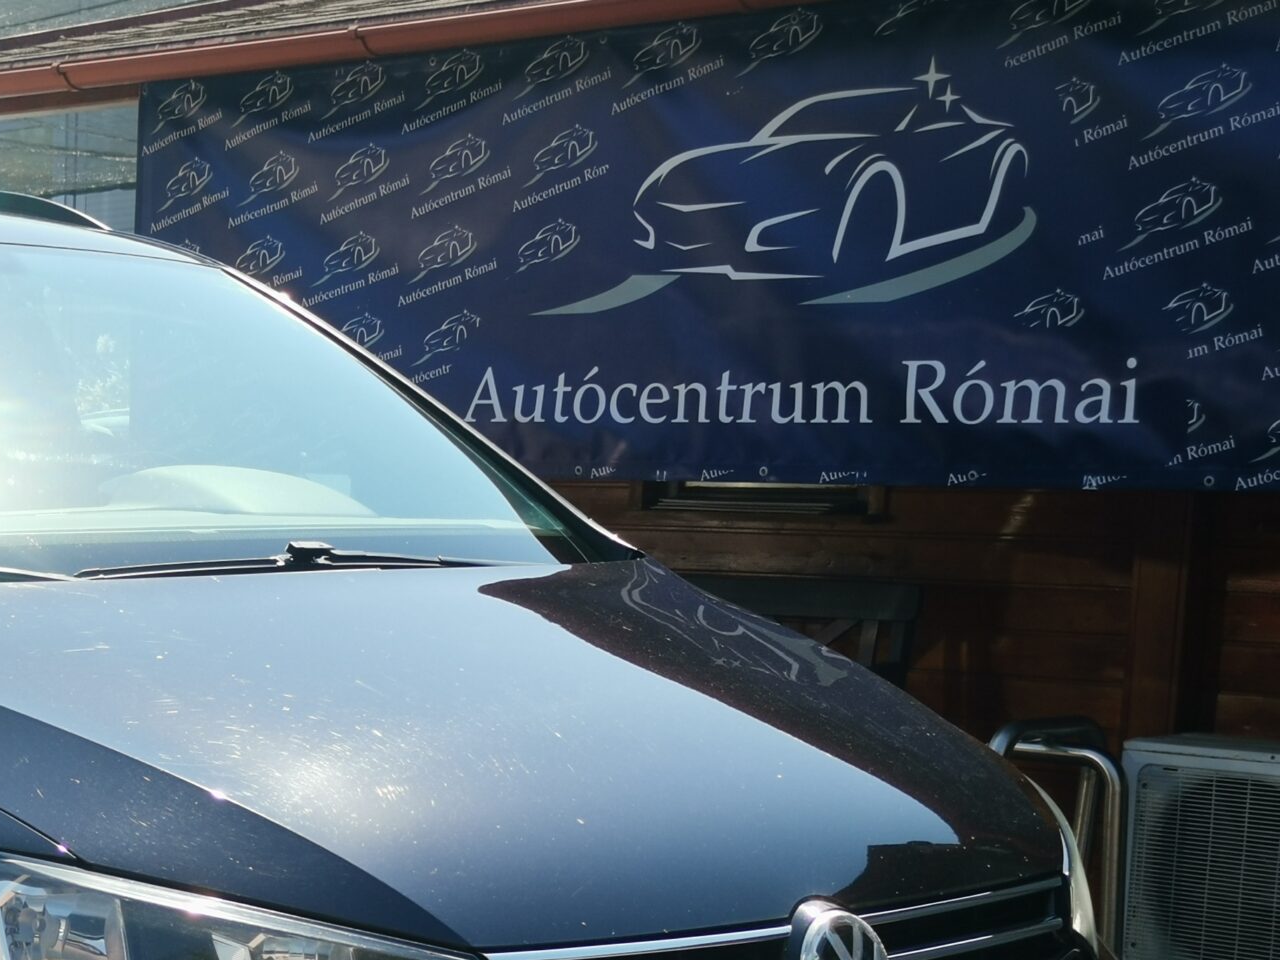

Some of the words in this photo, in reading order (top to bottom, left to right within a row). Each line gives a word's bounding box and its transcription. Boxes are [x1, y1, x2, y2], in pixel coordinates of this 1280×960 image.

[1004, 35, 1069, 68] ócentrum
[1073, 11, 1121, 40] Római
[1117, 20, 1221, 66] Autócentrum
[401, 100, 467, 136] Autócentrum
[470, 80, 502, 103] Római
[502, 85, 572, 126] Autócentrum
[575, 67, 612, 92] Római
[611, 76, 685, 116] Autócentrum
[687, 55, 724, 82] Római
[141, 125, 196, 157] Autócentrum
[197, 108, 223, 130] Római
[224, 118, 278, 151] Autócentrum
[281, 100, 312, 122] Római
[307, 109, 371, 144] Autócentrum
[373, 91, 405, 114] Római
[1083, 115, 1128, 144] Római
[1128, 124, 1225, 171] Autócentrum
[1229, 101, 1280, 131] Római
[150, 201, 202, 234] Autócentrum
[202, 186, 230, 208] Római
[227, 196, 289, 229] Autócentrum
[290, 181, 318, 203] Római
[320, 190, 377, 225] Autócentrum
[379, 174, 410, 197] Római
[410, 184, 475, 220] Autócentrum
[478, 166, 511, 190] Római
[512, 176, 582, 213] Autócentrum
[1078, 225, 1104, 246] mai
[1103, 239, 1200, 281] Autócentrum
[1203, 216, 1253, 245] Római
[273, 266, 303, 287] Római
[368, 263, 400, 285] Római
[397, 275, 463, 307] Autócentrum
[465, 258, 497, 280] Római
[376, 345, 403, 361] ómai
[1213, 323, 1264, 351] Római
[463, 365, 873, 425] Autócentrum
[900, 357, 1140, 425] Római
[1186, 435, 1236, 461] Római
